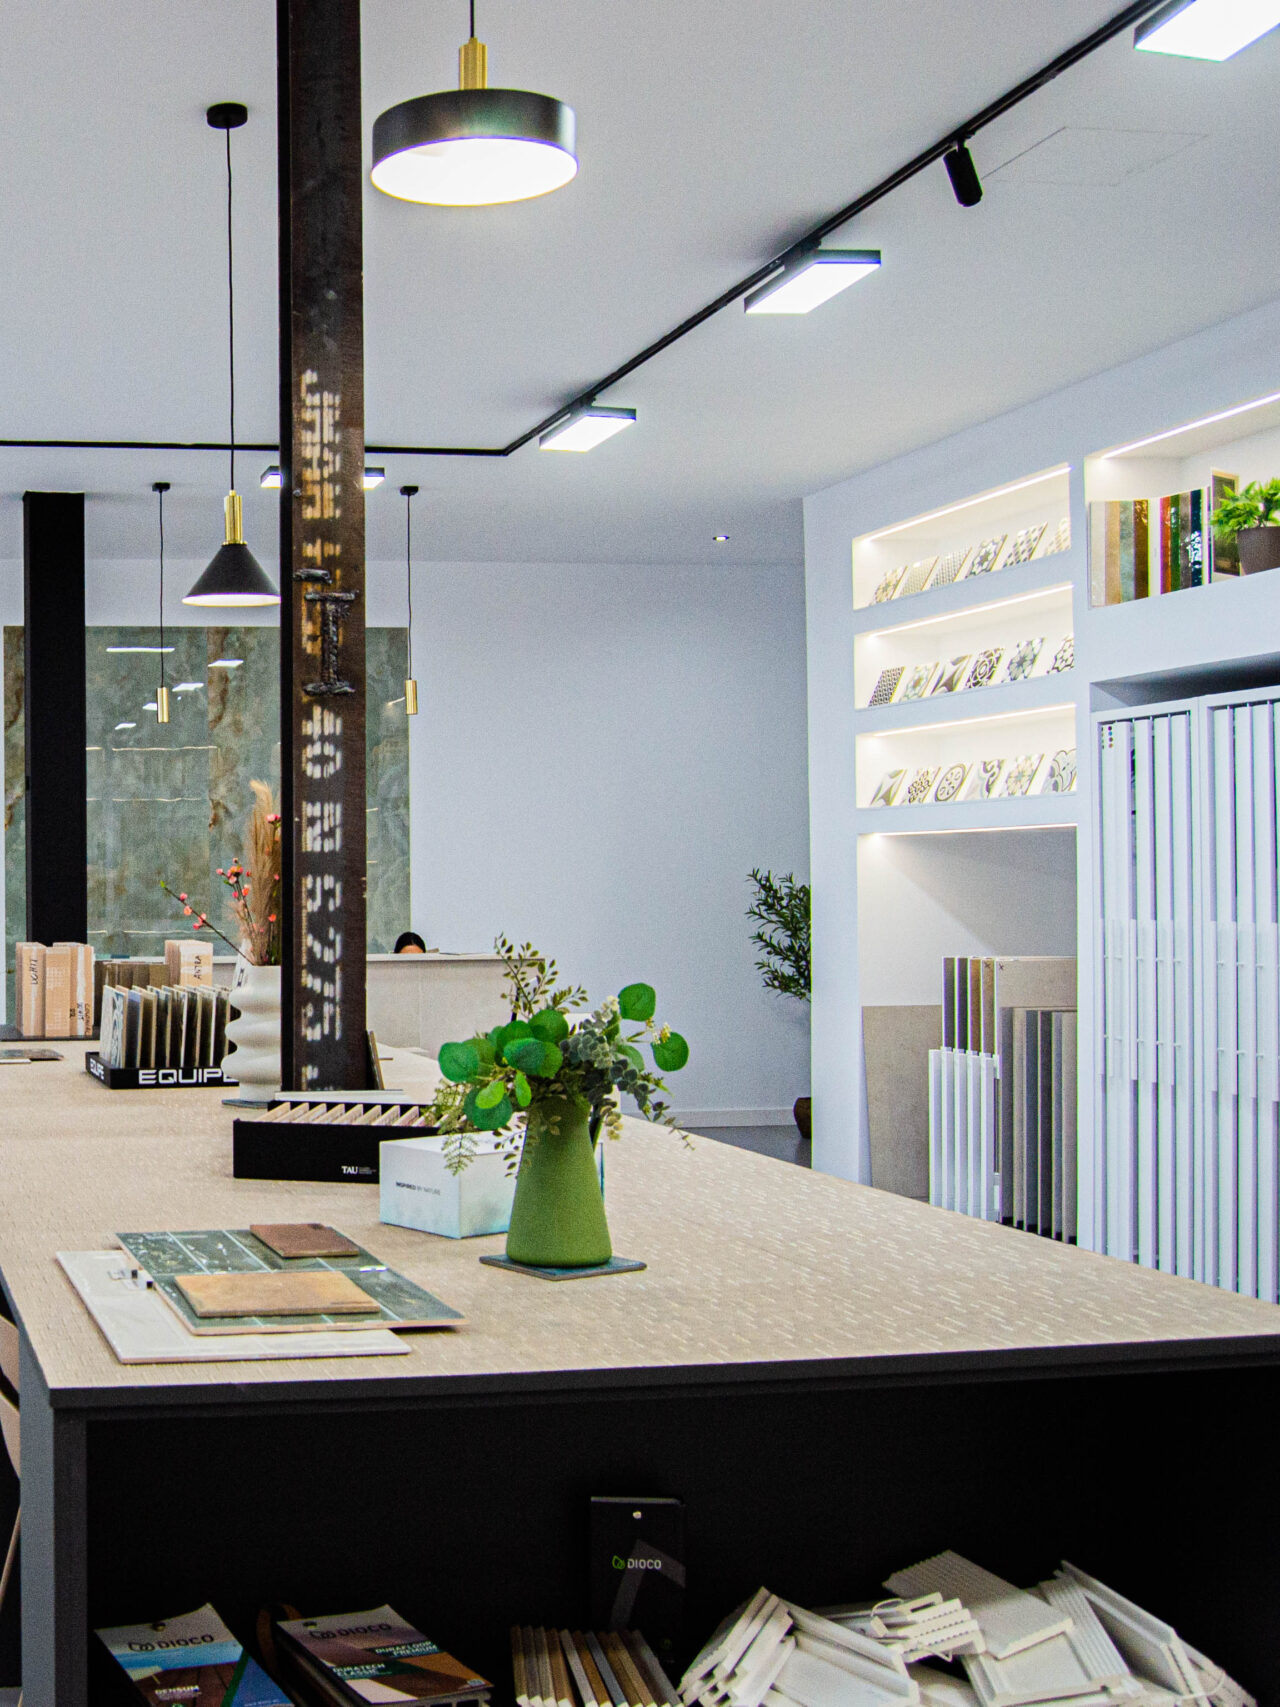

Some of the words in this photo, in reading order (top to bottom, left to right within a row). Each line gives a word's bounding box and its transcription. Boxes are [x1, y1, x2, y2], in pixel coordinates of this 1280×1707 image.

[341, 1165, 359, 1175] TAU
[627, 1558, 662, 1569] DIOCO
[336, 1623, 392, 1636] DIOCO
[157, 1633, 215, 1649] DIOCO
